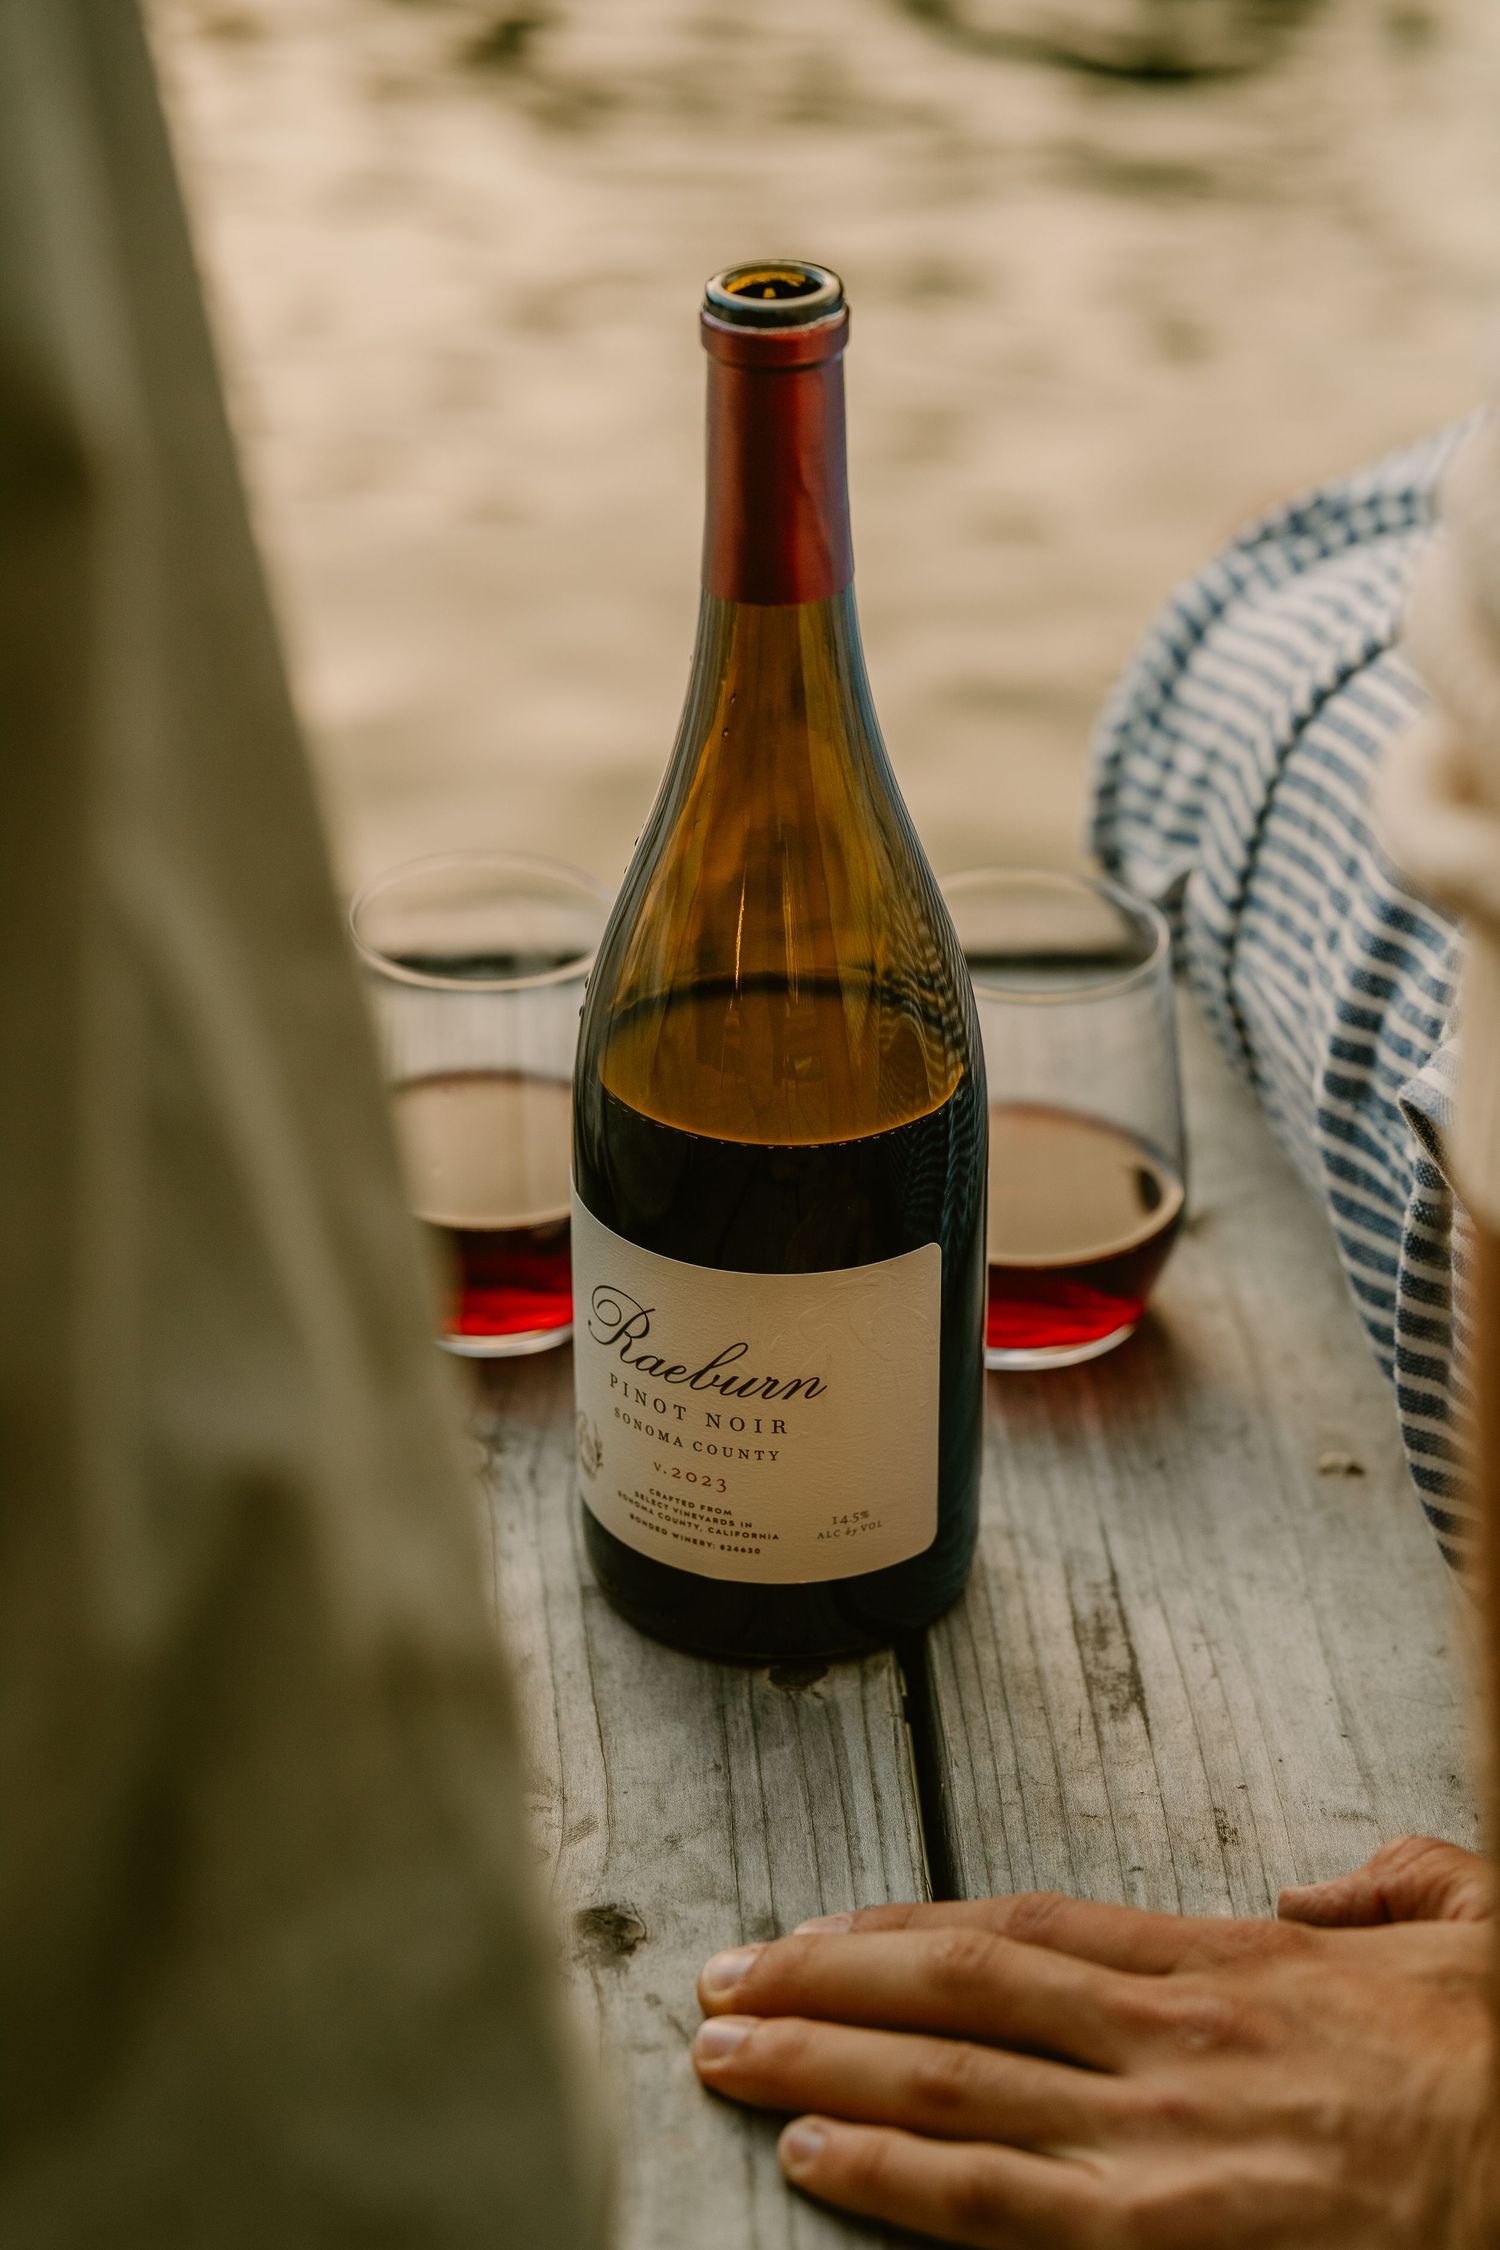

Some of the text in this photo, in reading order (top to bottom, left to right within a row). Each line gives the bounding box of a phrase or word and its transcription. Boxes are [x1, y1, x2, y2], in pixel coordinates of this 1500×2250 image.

[588, 1285, 828, 1400] Raeburn
[610, 1373, 788, 1434] PINOT NOIR
[614, 1407, 780, 1461] SONOMA COUNTY
[617, 1490, 780, 1540] SONOMA COUNTY, CALIFORNIA
[634, 1491, 669, 1510] SELECT
[672, 1507, 735, 1527] VINEYARDS
[649, 1488, 732, 1516] CRAFTED FROM
[629, 1512, 669, 1535] BONDED
[672, 1532, 715, 1550] WINERY:
[817, 1520, 883, 1540] ALC by VOL
